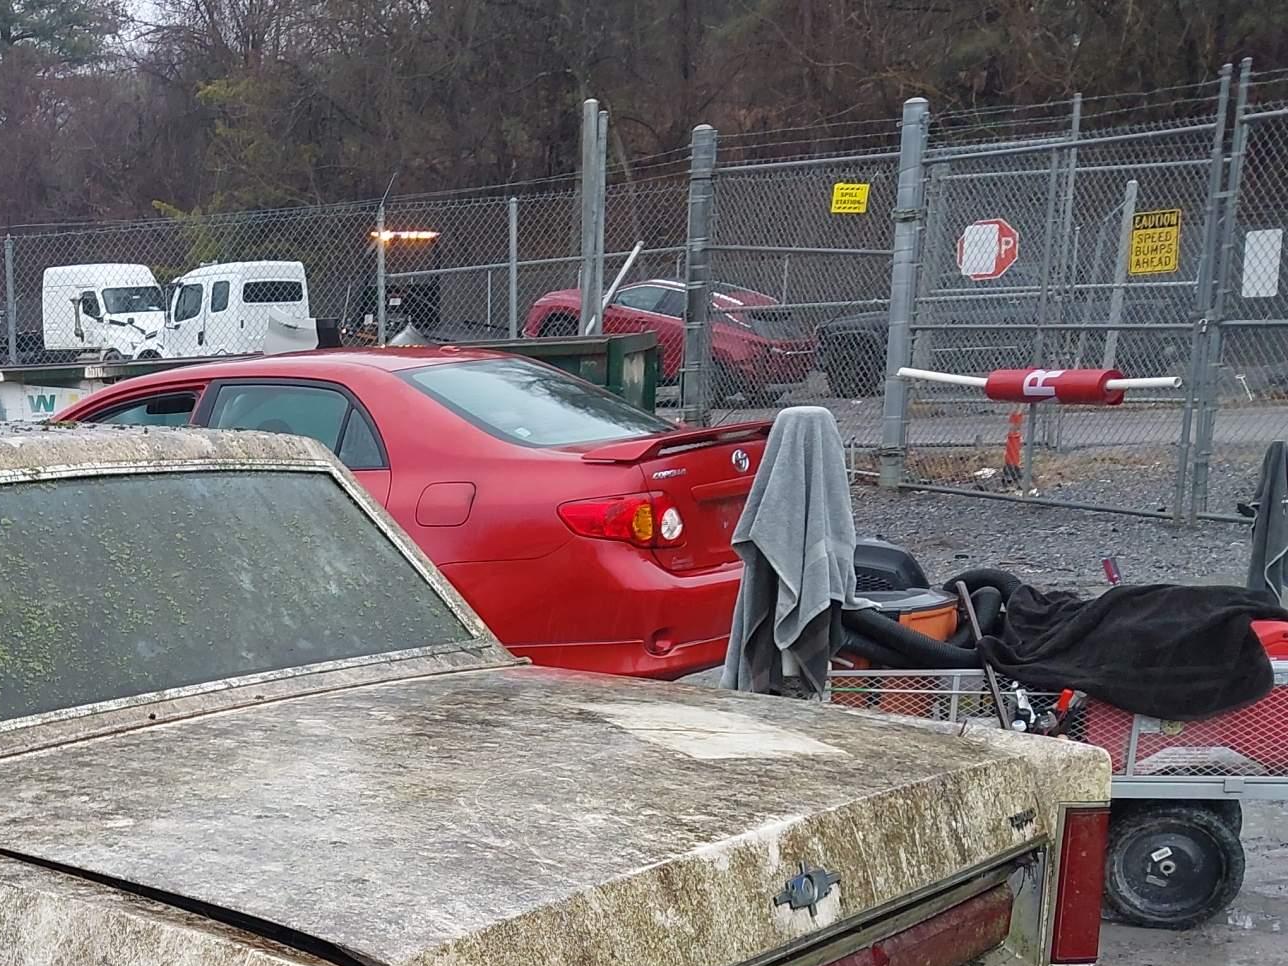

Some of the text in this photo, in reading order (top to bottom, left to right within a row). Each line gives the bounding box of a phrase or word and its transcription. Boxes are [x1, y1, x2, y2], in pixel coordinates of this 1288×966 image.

[1134, 213, 1177, 228] CAUTION
[1136, 231, 1172, 244] SPEED
[1134, 243, 1173, 256] BUMPS
[1134, 256, 1172, 269] AHEAD
